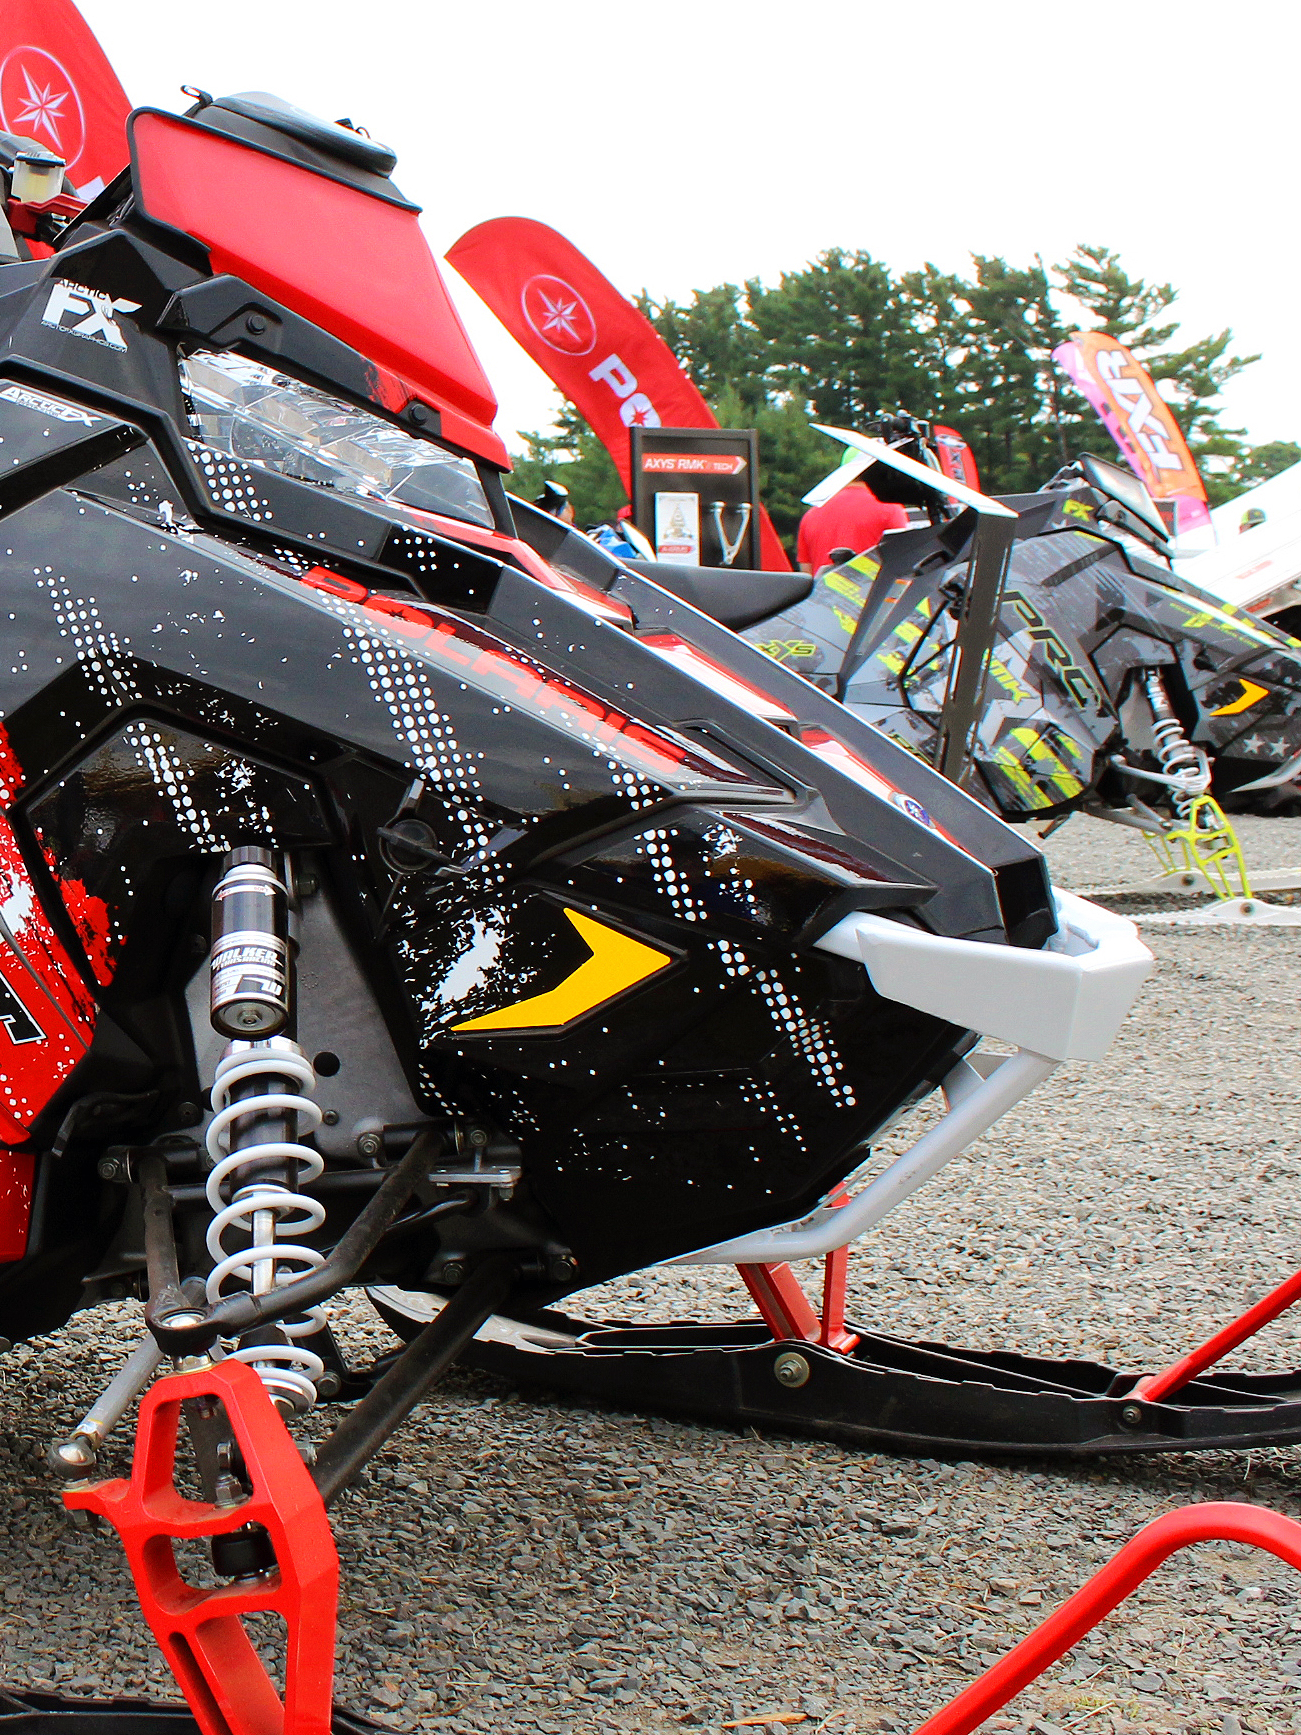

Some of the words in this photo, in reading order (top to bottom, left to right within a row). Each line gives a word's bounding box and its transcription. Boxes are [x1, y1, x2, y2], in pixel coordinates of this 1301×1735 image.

[41, 284, 143, 349] FX
[1062, 498, 1095, 522] FX
[301, 565, 687, 774] POLARIS
[210, 947, 284, 971] WALKER
